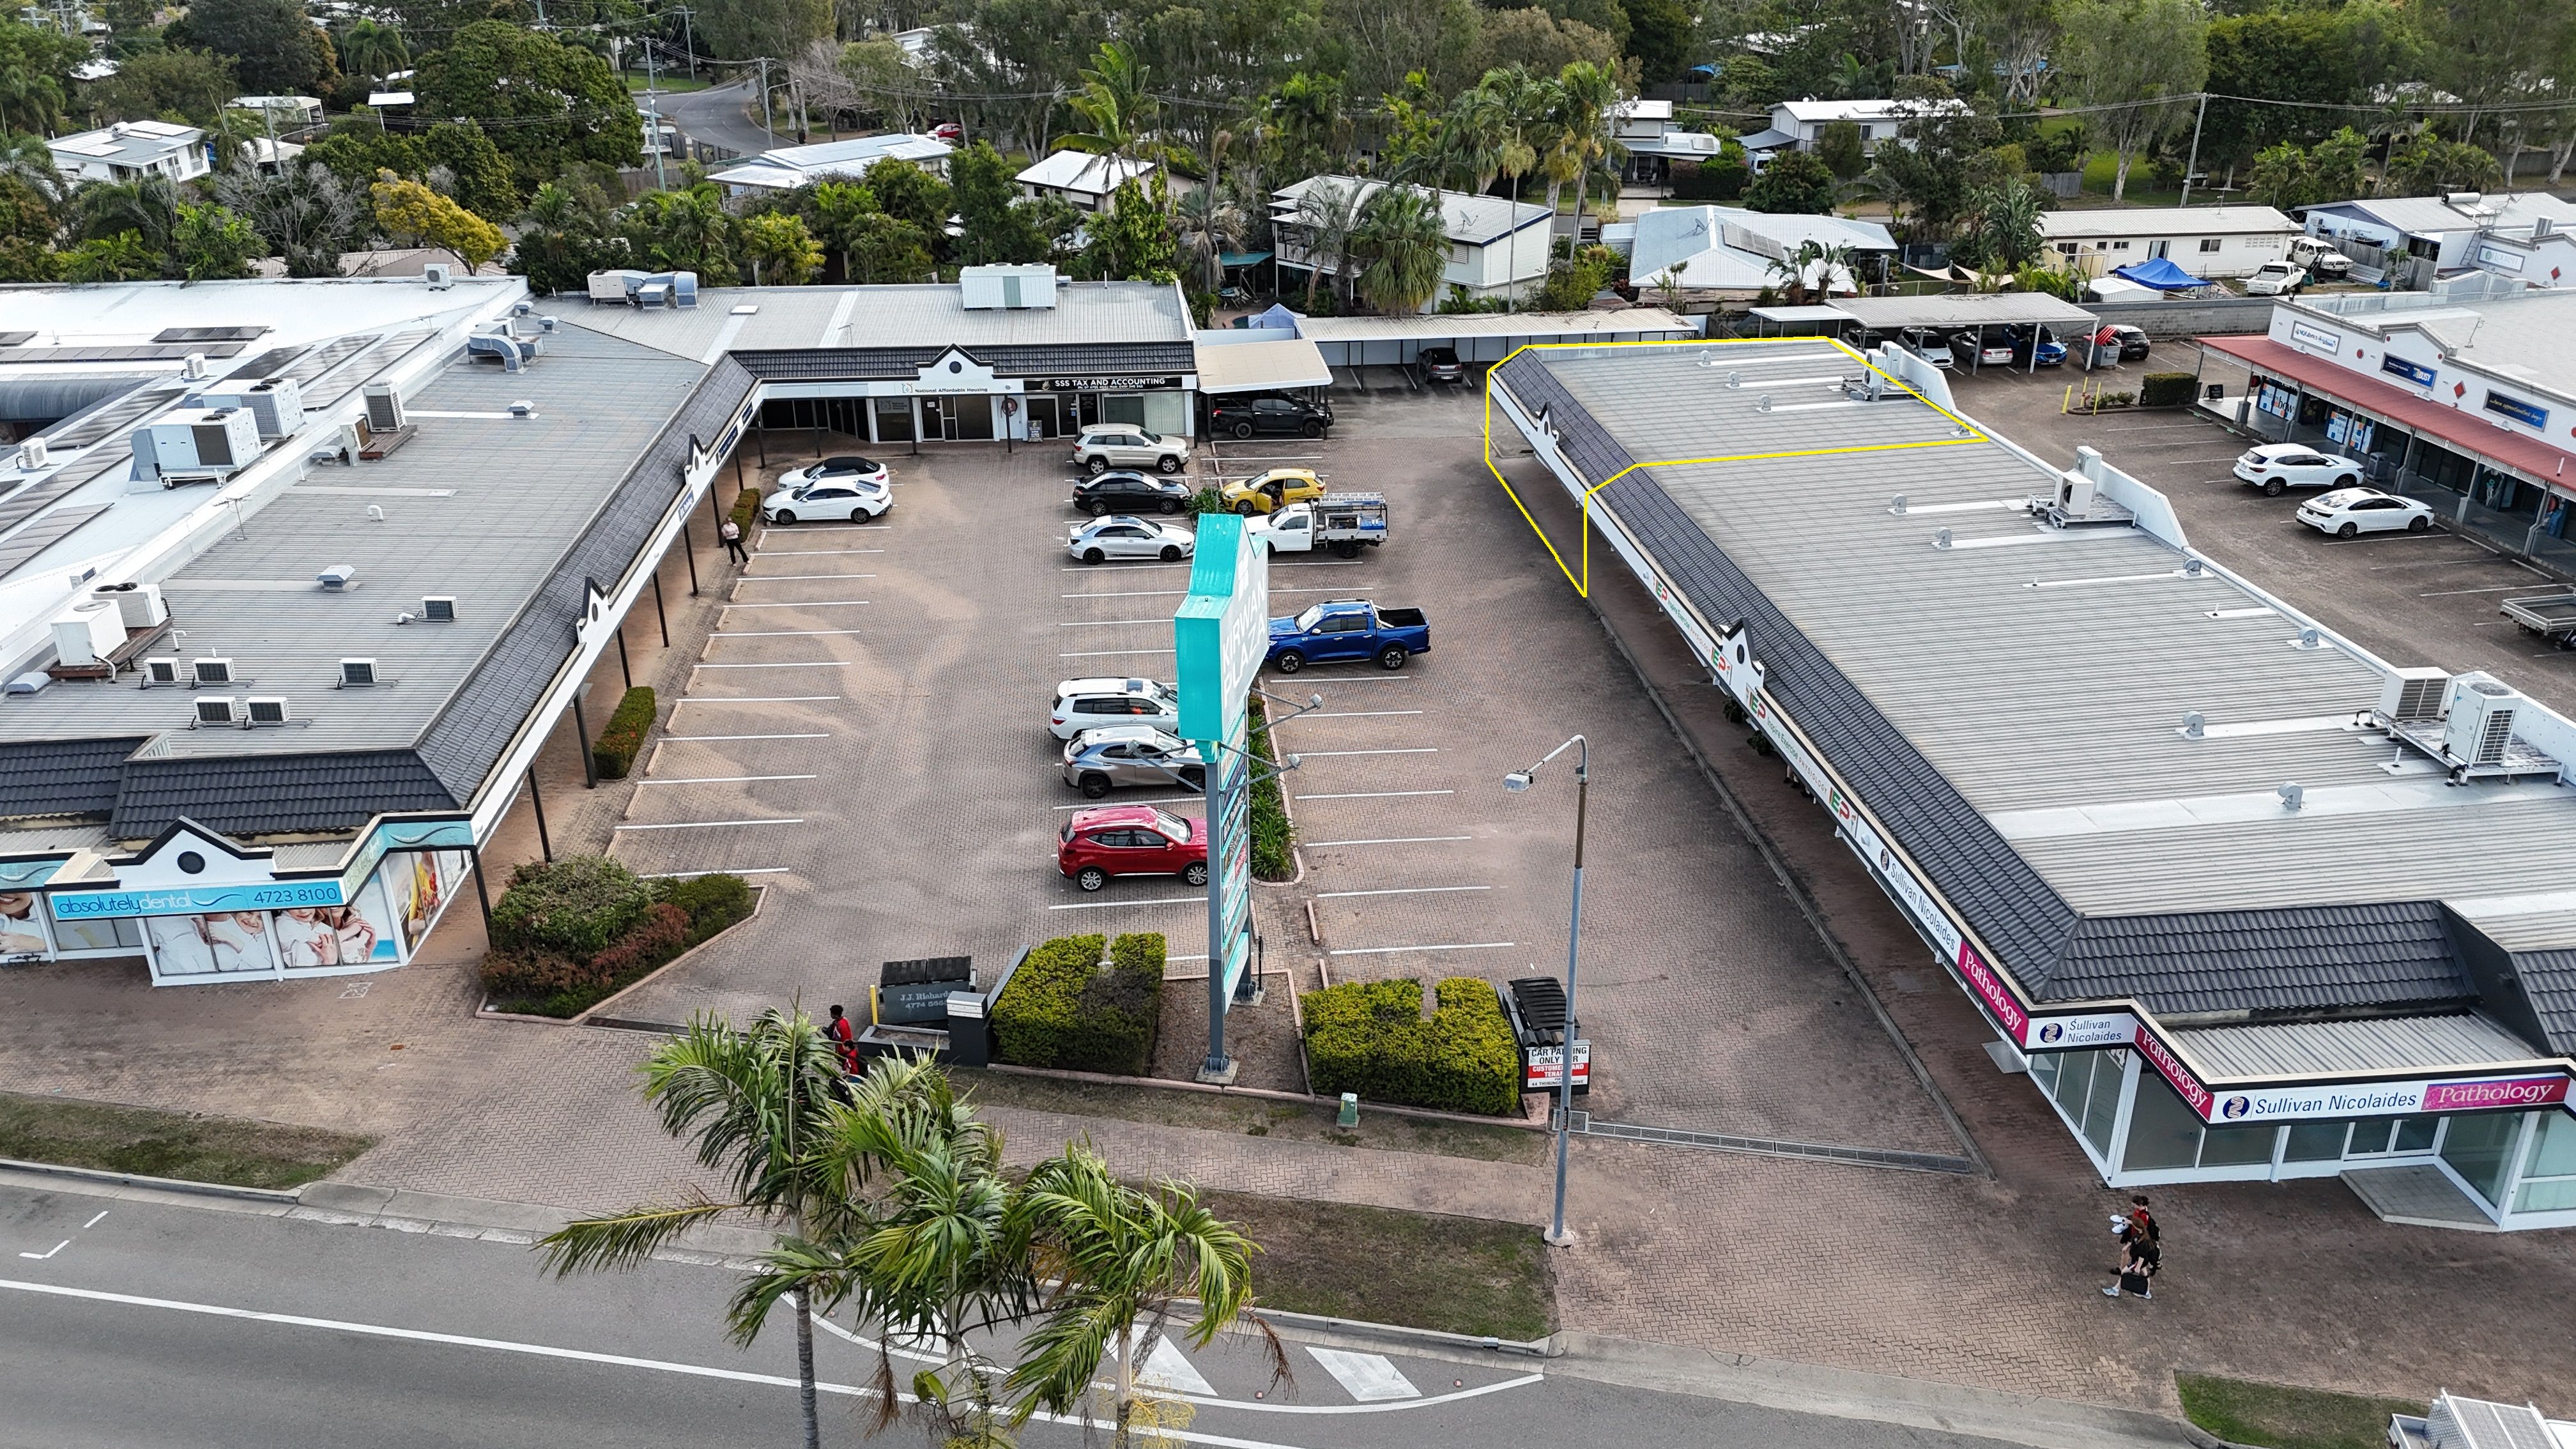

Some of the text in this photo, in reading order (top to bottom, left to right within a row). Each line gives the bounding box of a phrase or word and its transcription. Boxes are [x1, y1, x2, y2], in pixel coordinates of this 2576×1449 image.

[1112, 378, 1165, 386] ACCOUNTING
[1222, 573, 1266, 674] KIRWAN
[1224, 612, 1266, 709] PLAZA
[1767, 717, 1781, 739] Inspire
[1781, 734, 1798, 760] Exercise
[1798, 756, 1828, 794] PHYSIOLOGY
[254, 889, 293, 904] 4723
[298, 887, 337, 902] 8100
[1890, 864, 2022, 1031] Sullivan Nicolaides Pathology
[2067, 1031, 2122, 1043] Nicolaides
[2069, 1020, 2111, 1031] Sullivan
[1531, 1047, 1587, 1057] CAR PAING
[1539, 1056, 1560, 1064] ONLY
[2143, 1031, 2208, 1108] Pathology
[2255, 1084, 2555, 1114] Sullivan Nicolaides Pathology
